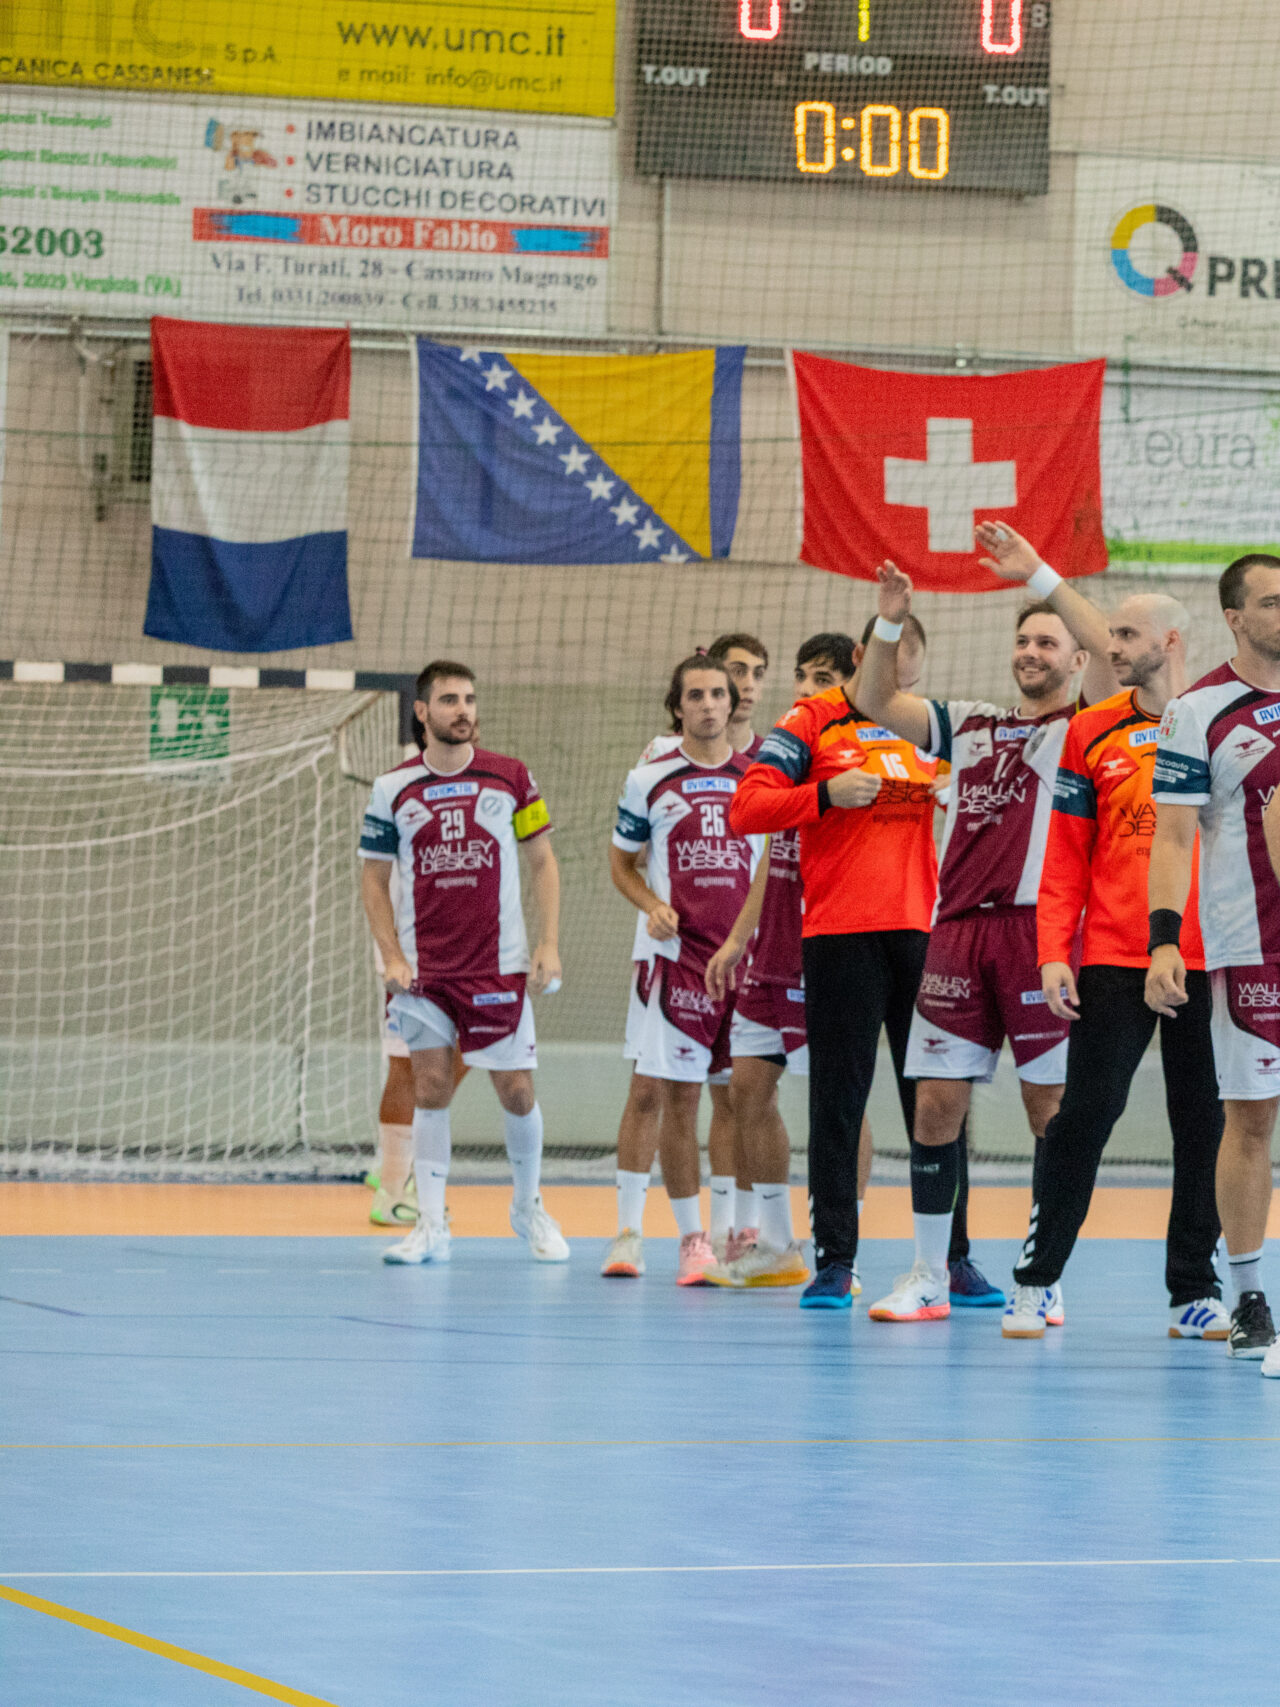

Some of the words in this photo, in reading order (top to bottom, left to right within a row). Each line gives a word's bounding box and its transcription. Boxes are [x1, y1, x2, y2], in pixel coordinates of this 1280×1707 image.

[337, 19, 567, 57] www.umc.it
[642, 65, 710, 87] T.OUT
[804, 52, 893, 77] PERIOD
[983, 84, 1048, 107] T.OUT
[306, 121, 521, 152] IMBIANCATURA
[794, 101, 949, 180] 0:00
[306, 152, 515, 182] VERNICIATURA
[305, 182, 431, 211] STUCCHI
[439, 189, 607, 219] DECORATIVI
[320, 213, 401, 248] Moro
[413, 218, 498, 252] Fabio
[360, 258, 383, 280] 28
[405, 259, 493, 284] Cassano
[502, 265, 599, 291] Magnago
[879, 753, 910, 779] 16
[440, 808, 466, 841] 29
[701, 803, 726, 838] 26
[418, 838, 494, 861] WALLEY
[676, 839, 748, 857] WALLEY
[420, 853, 494, 876] DESIGN
[677, 855, 748, 872] DESIGN
